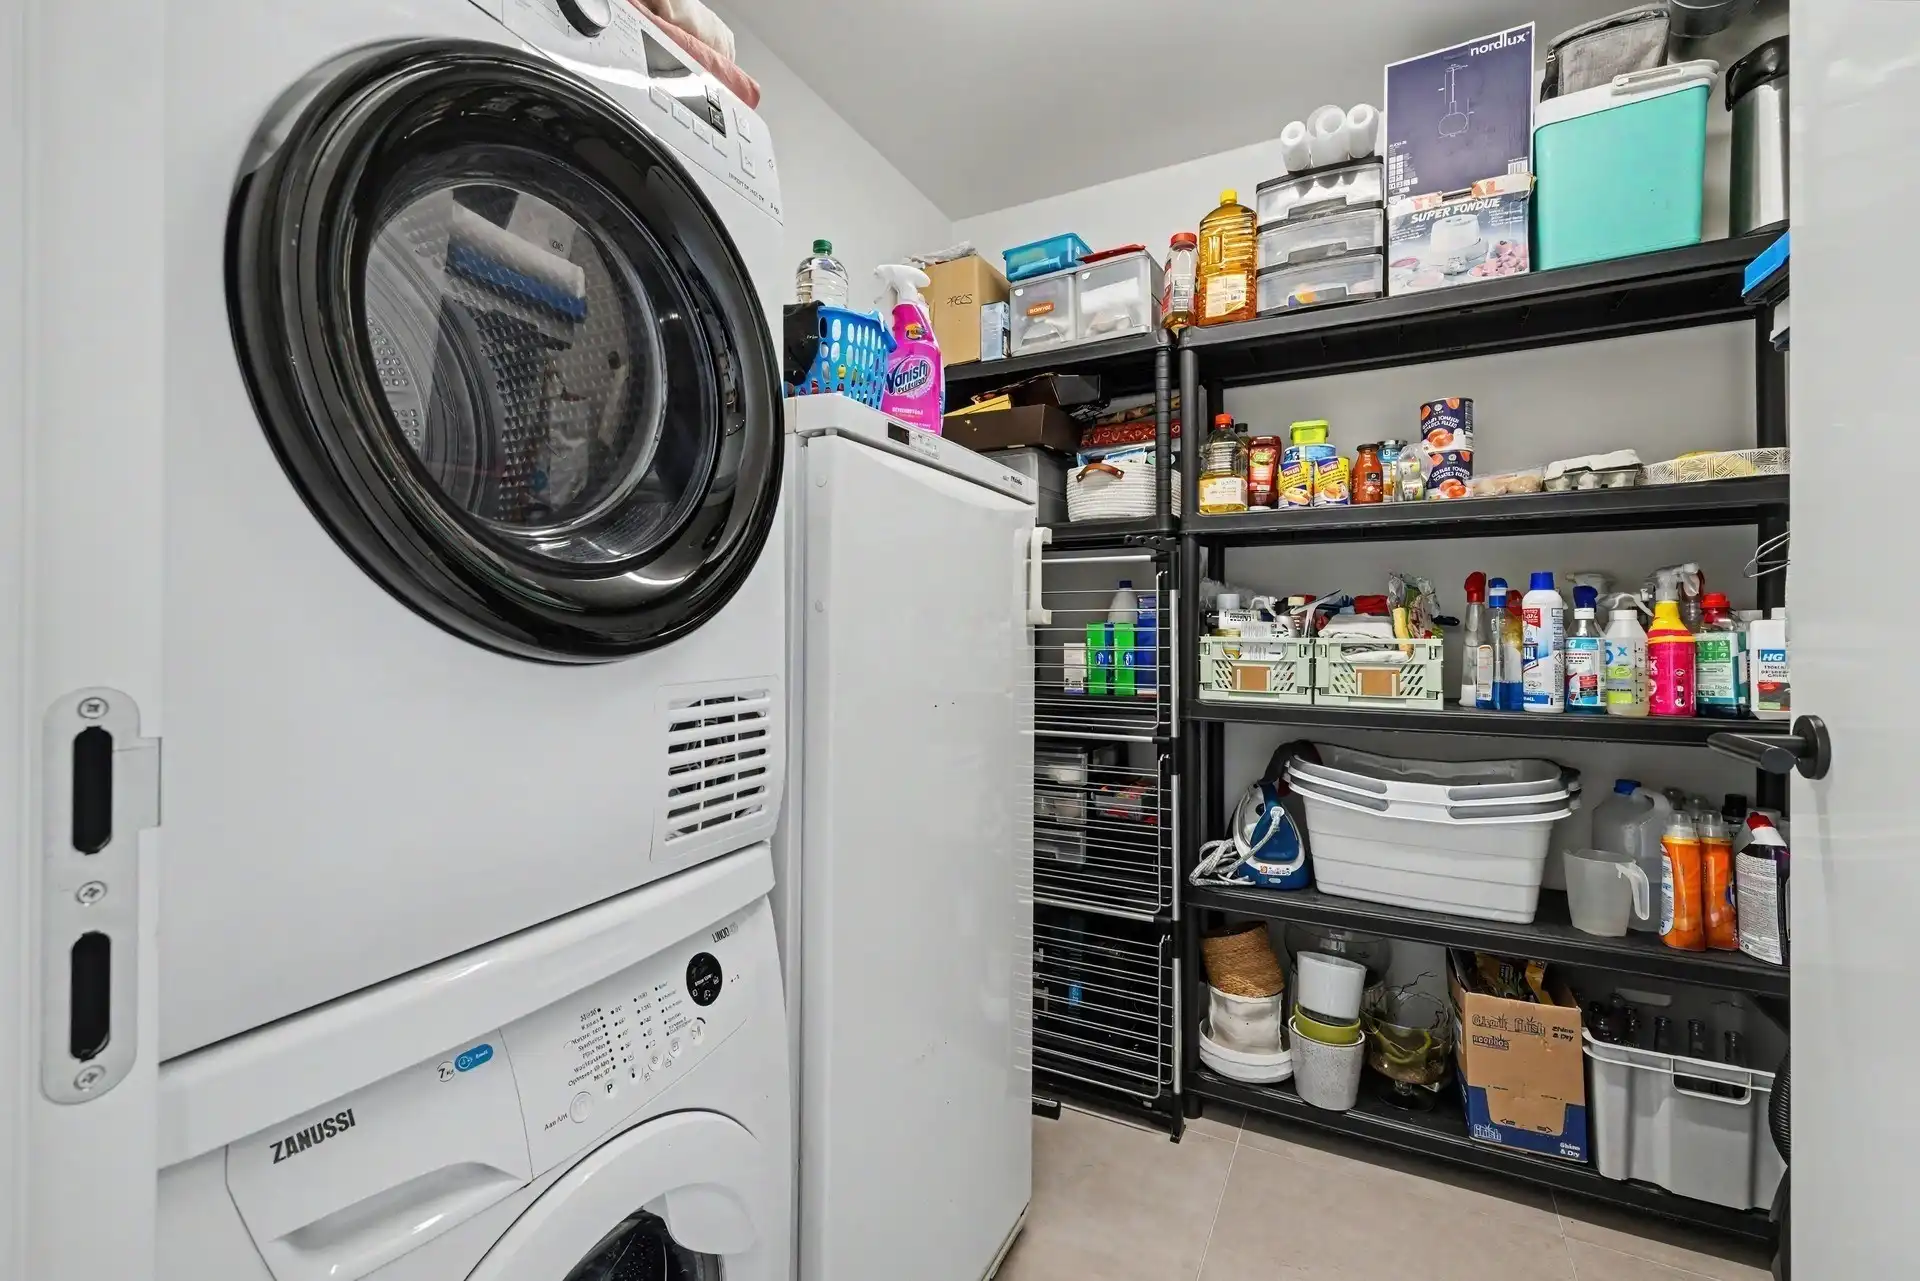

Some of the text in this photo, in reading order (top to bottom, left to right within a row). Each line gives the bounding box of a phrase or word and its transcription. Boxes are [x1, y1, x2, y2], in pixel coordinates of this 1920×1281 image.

[1470, 32, 1526, 56] nordlux
[1411, 207, 1451, 224] SUPER
[1452, 198, 1501, 215] FONDUE
[886, 355, 928, 395] Vanish
[1762, 653, 1785, 661] HG
[606, 1083, 613, 1094] P
[269, 1108, 356, 1165] ZANUSSI
[1473, 1123, 1502, 1143] finish
[1567, 1150, 1580, 1158] Dry
